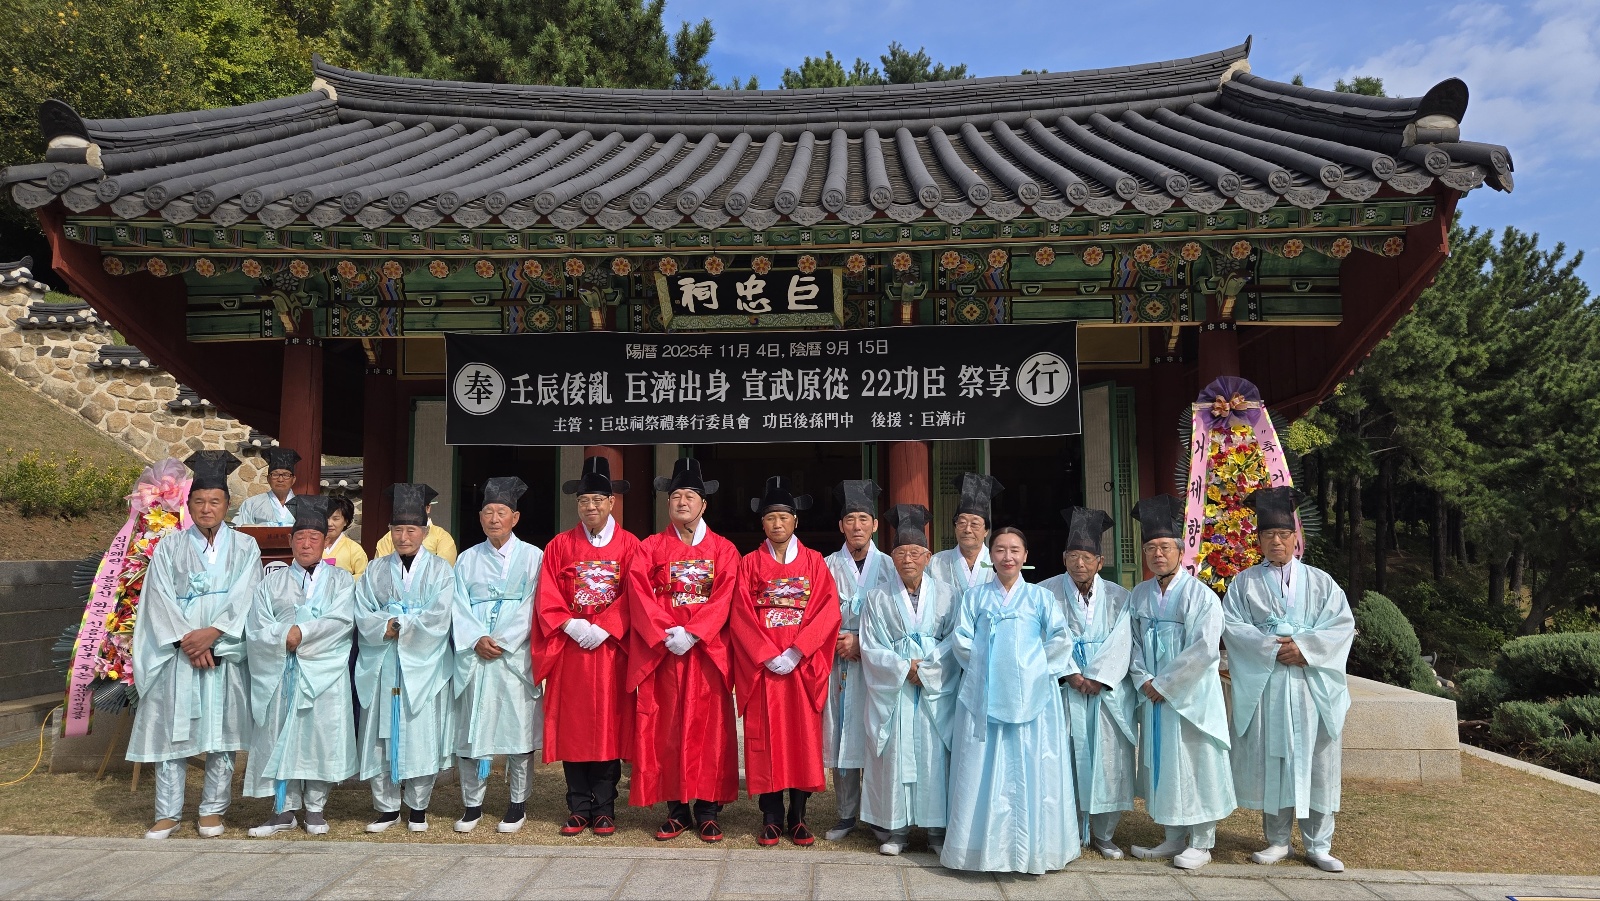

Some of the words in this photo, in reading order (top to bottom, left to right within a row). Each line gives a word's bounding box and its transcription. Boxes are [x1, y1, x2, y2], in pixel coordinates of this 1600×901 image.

[662, 344, 714, 359] 2025年
[719, 344, 750, 358] 11月
[757, 344, 785, 359] 4日,
[827, 341, 849, 356] 9月
[858, 340, 888, 354] 15日
[465, 371, 494, 405] 奉
[510, 371, 613, 406] 壬辰倭亂
[624, 369, 731, 404] 巨濟出身
[741, 367, 850, 402] 宣武原從
[861, 366, 947, 400] 22功臣
[958, 364, 1011, 398] 祭享
[1026, 360, 1060, 396] 行
[600, 413, 751, 432] 巨忠祠祭禮奉行委員會
[763, 411, 854, 430] 功臣後孫門中
[921, 410, 966, 427] 巨濟市
[108, 535, 127, 565] 임진왜란
